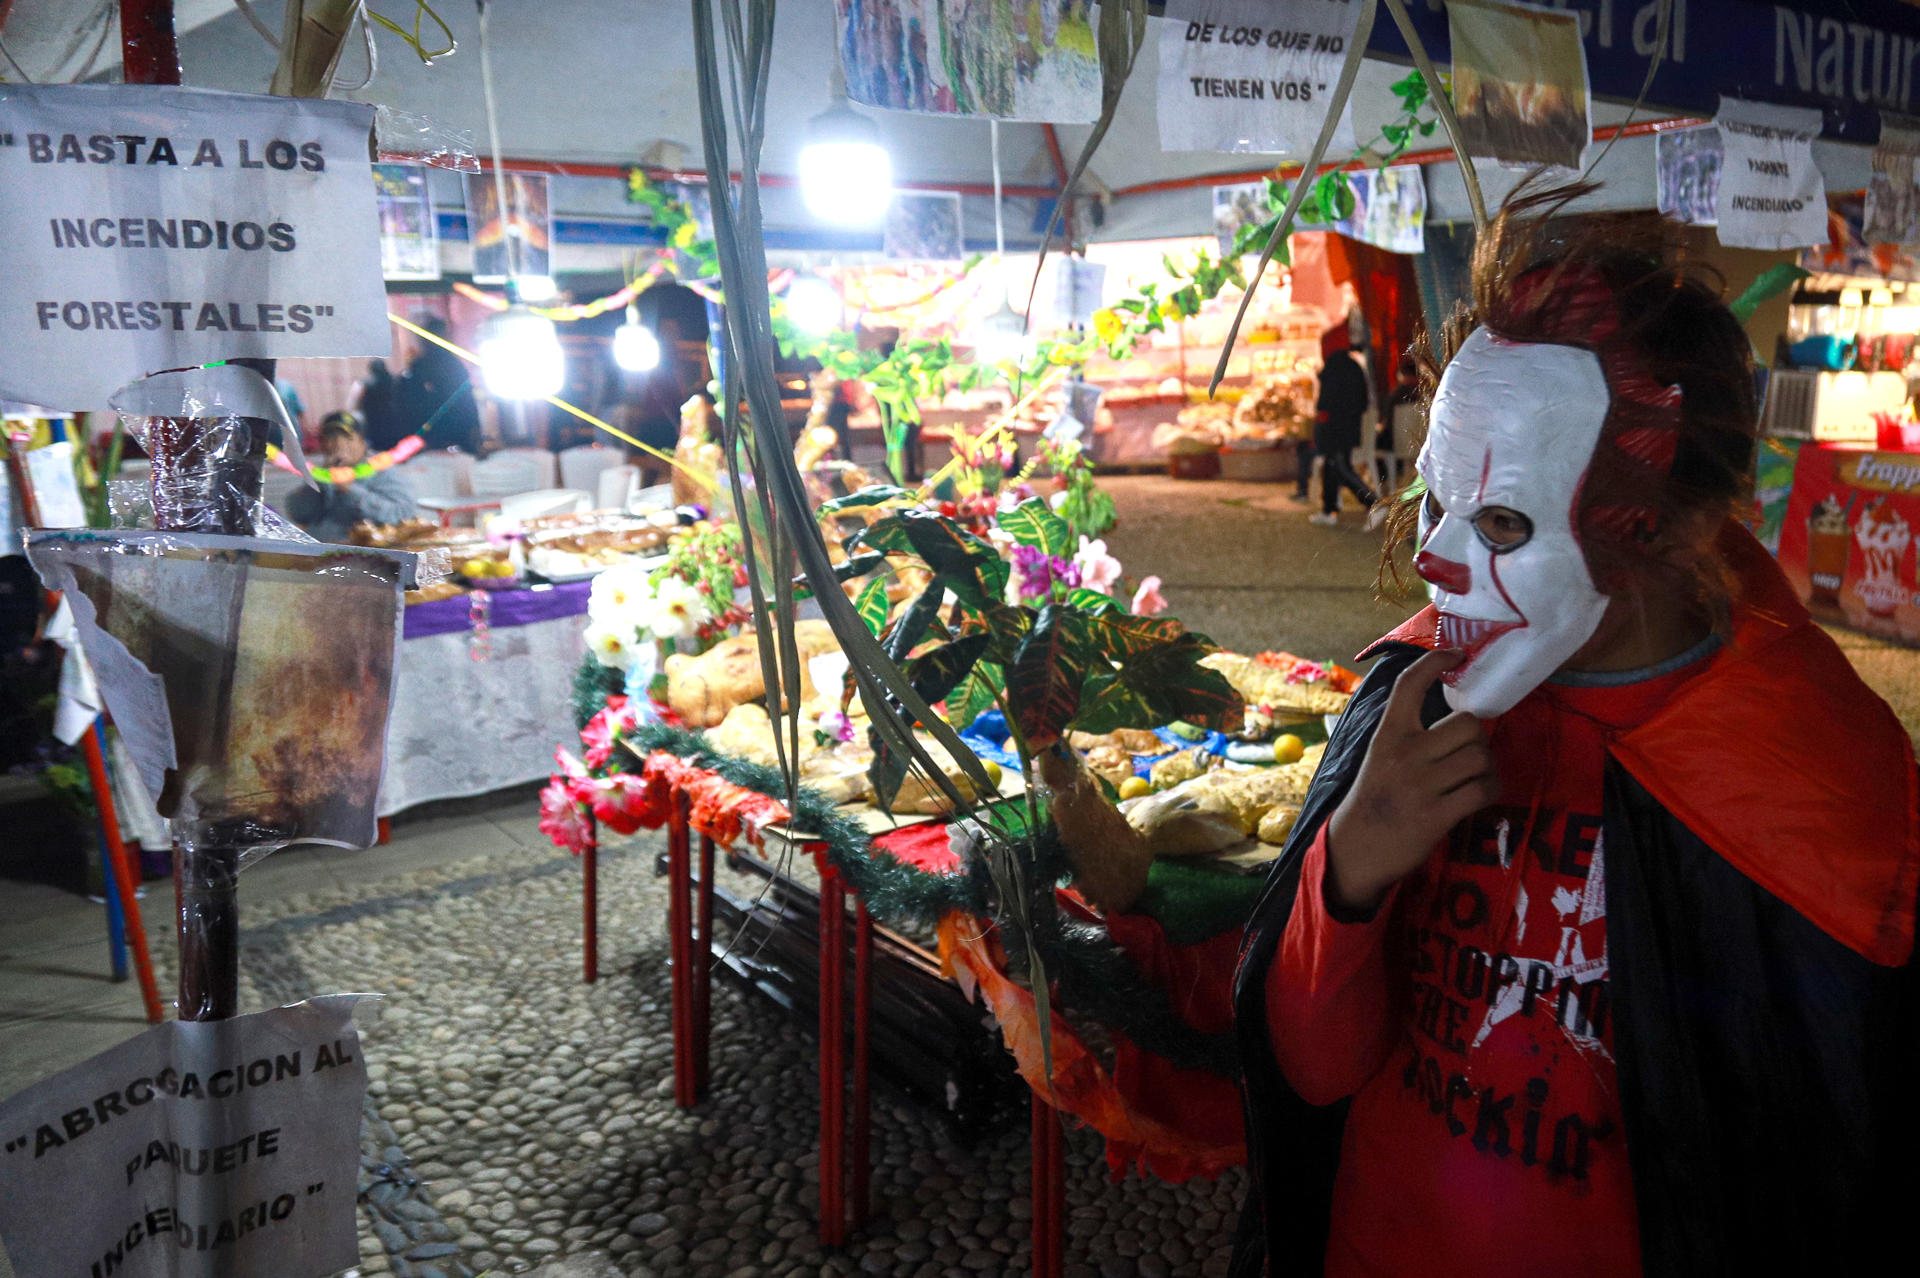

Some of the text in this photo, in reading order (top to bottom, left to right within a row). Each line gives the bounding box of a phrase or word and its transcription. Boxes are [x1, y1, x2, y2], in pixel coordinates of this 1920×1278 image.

[1186, 21, 1344, 53] DE LOS QUE NO
[1190, 77, 1264, 99] TIENEN
[1271, 80, 1312, 101] VOS
[28, 134, 178, 166] BASTA
[192, 139, 224, 168] A
[239, 139, 325, 173] LOS
[50, 218, 297, 253] INCENDIOS
[312, 1040, 353, 1073] AL
